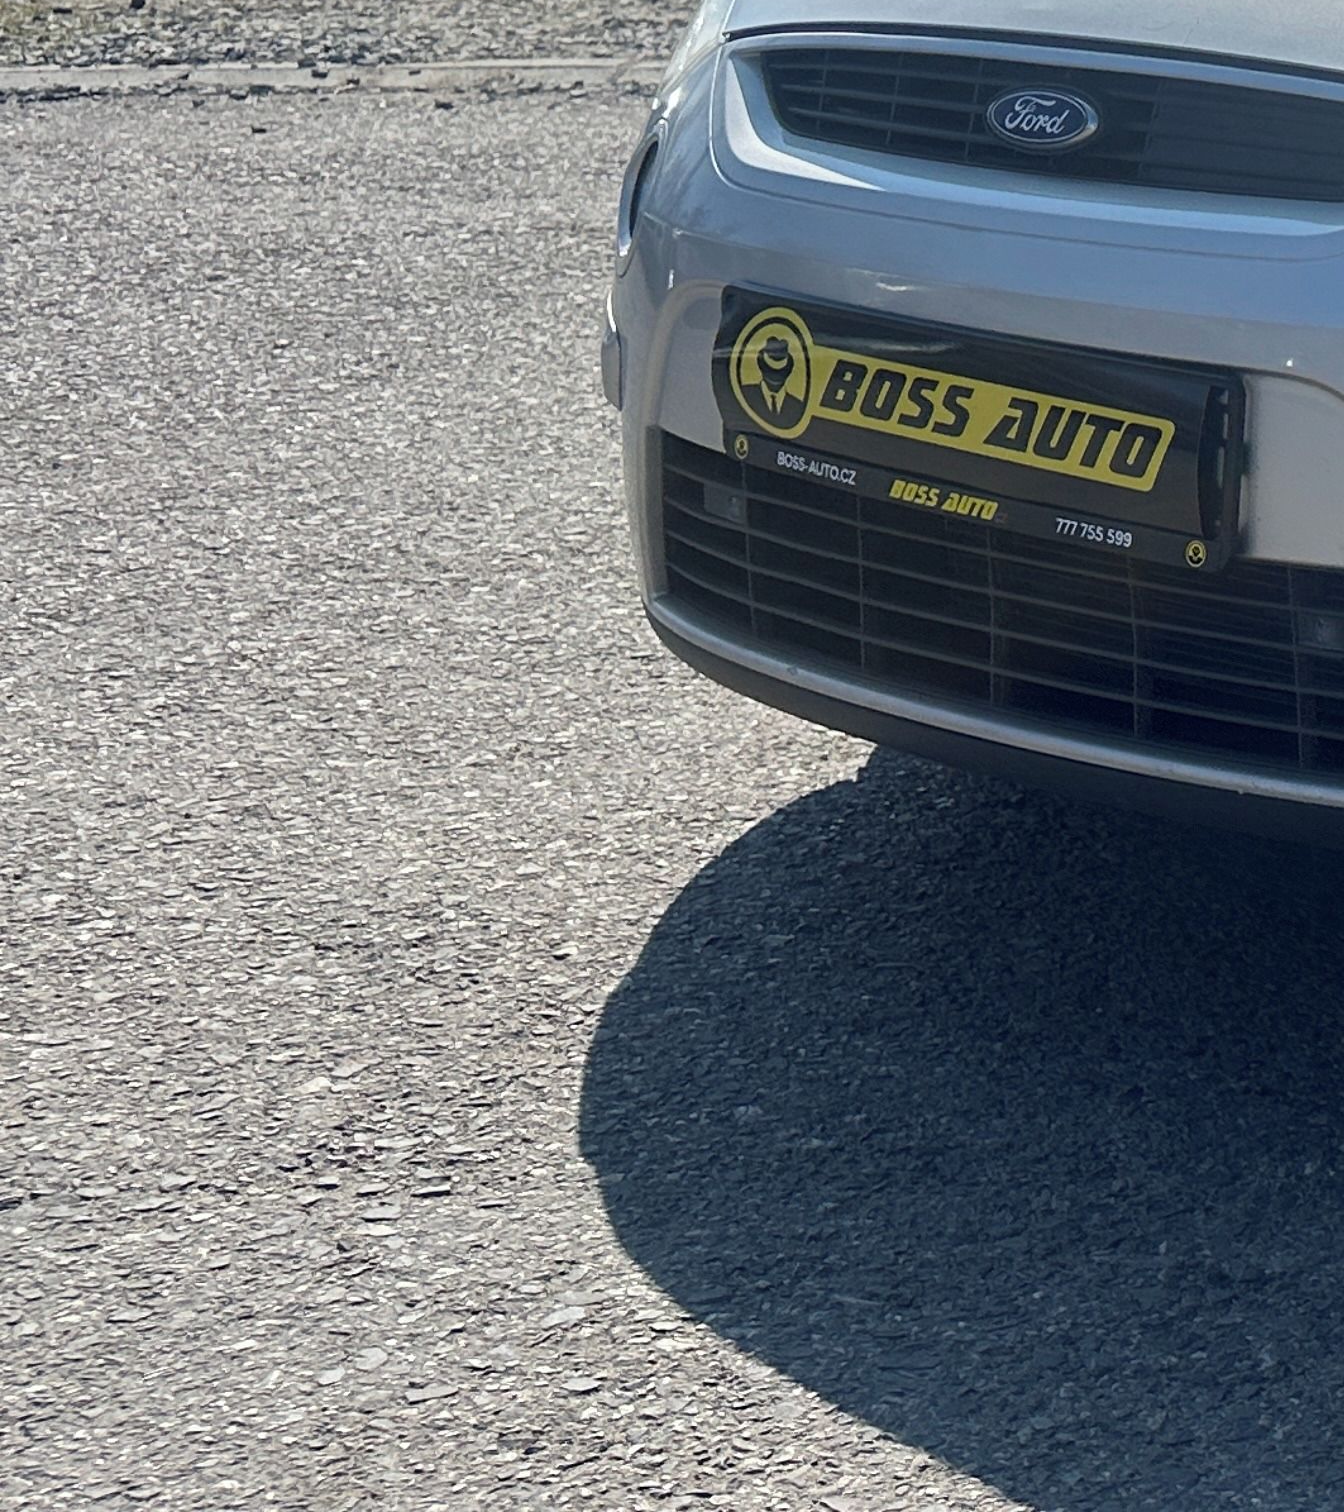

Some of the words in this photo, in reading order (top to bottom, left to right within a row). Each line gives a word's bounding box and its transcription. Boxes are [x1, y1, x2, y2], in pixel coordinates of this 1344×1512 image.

[1005, 96, 1070, 134] Ford
[820, 360, 975, 437] BOSS
[984, 396, 1163, 478] AUTO
[777, 451, 856, 485] BOSS-AUTO.CZ
[889, 479, 939, 507] BOSS
[942, 491, 998, 521] AUTO
[1055, 517, 1078, 535] 777
[1079, 522, 1104, 541] 755
[1107, 529, 1132, 548] 599
